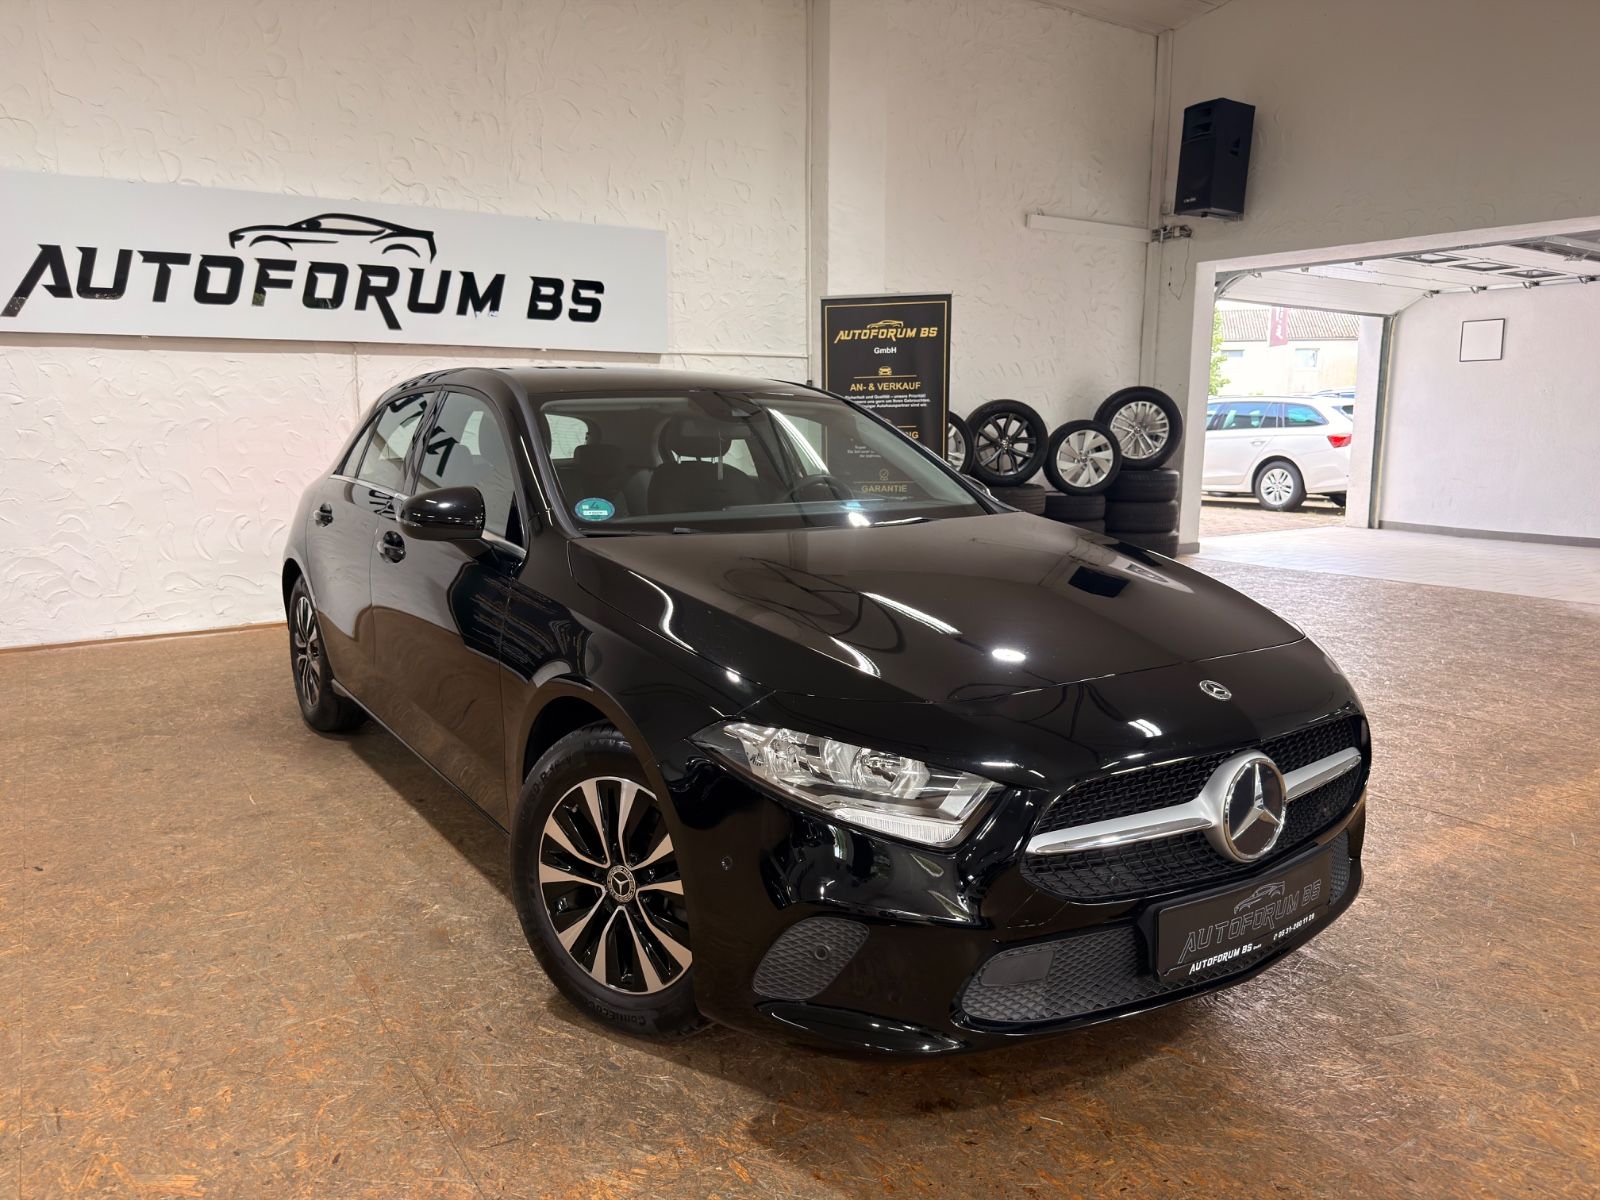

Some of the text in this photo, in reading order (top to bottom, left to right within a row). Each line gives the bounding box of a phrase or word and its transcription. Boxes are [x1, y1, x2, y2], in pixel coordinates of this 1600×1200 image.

[1, 243, 605, 331] AUTOFORUM BS
[833, 327, 938, 344] AUTOFORUM BS
[873, 346, 897, 354] GmbH
[849, 381, 921, 391] AN- & VERKAUF
[861, 484, 908, 494] GARANTIE
[1177, 879, 1322, 965] AUTOFORUM BS
[1188, 943, 1253, 976] AUTOFORUM BS
